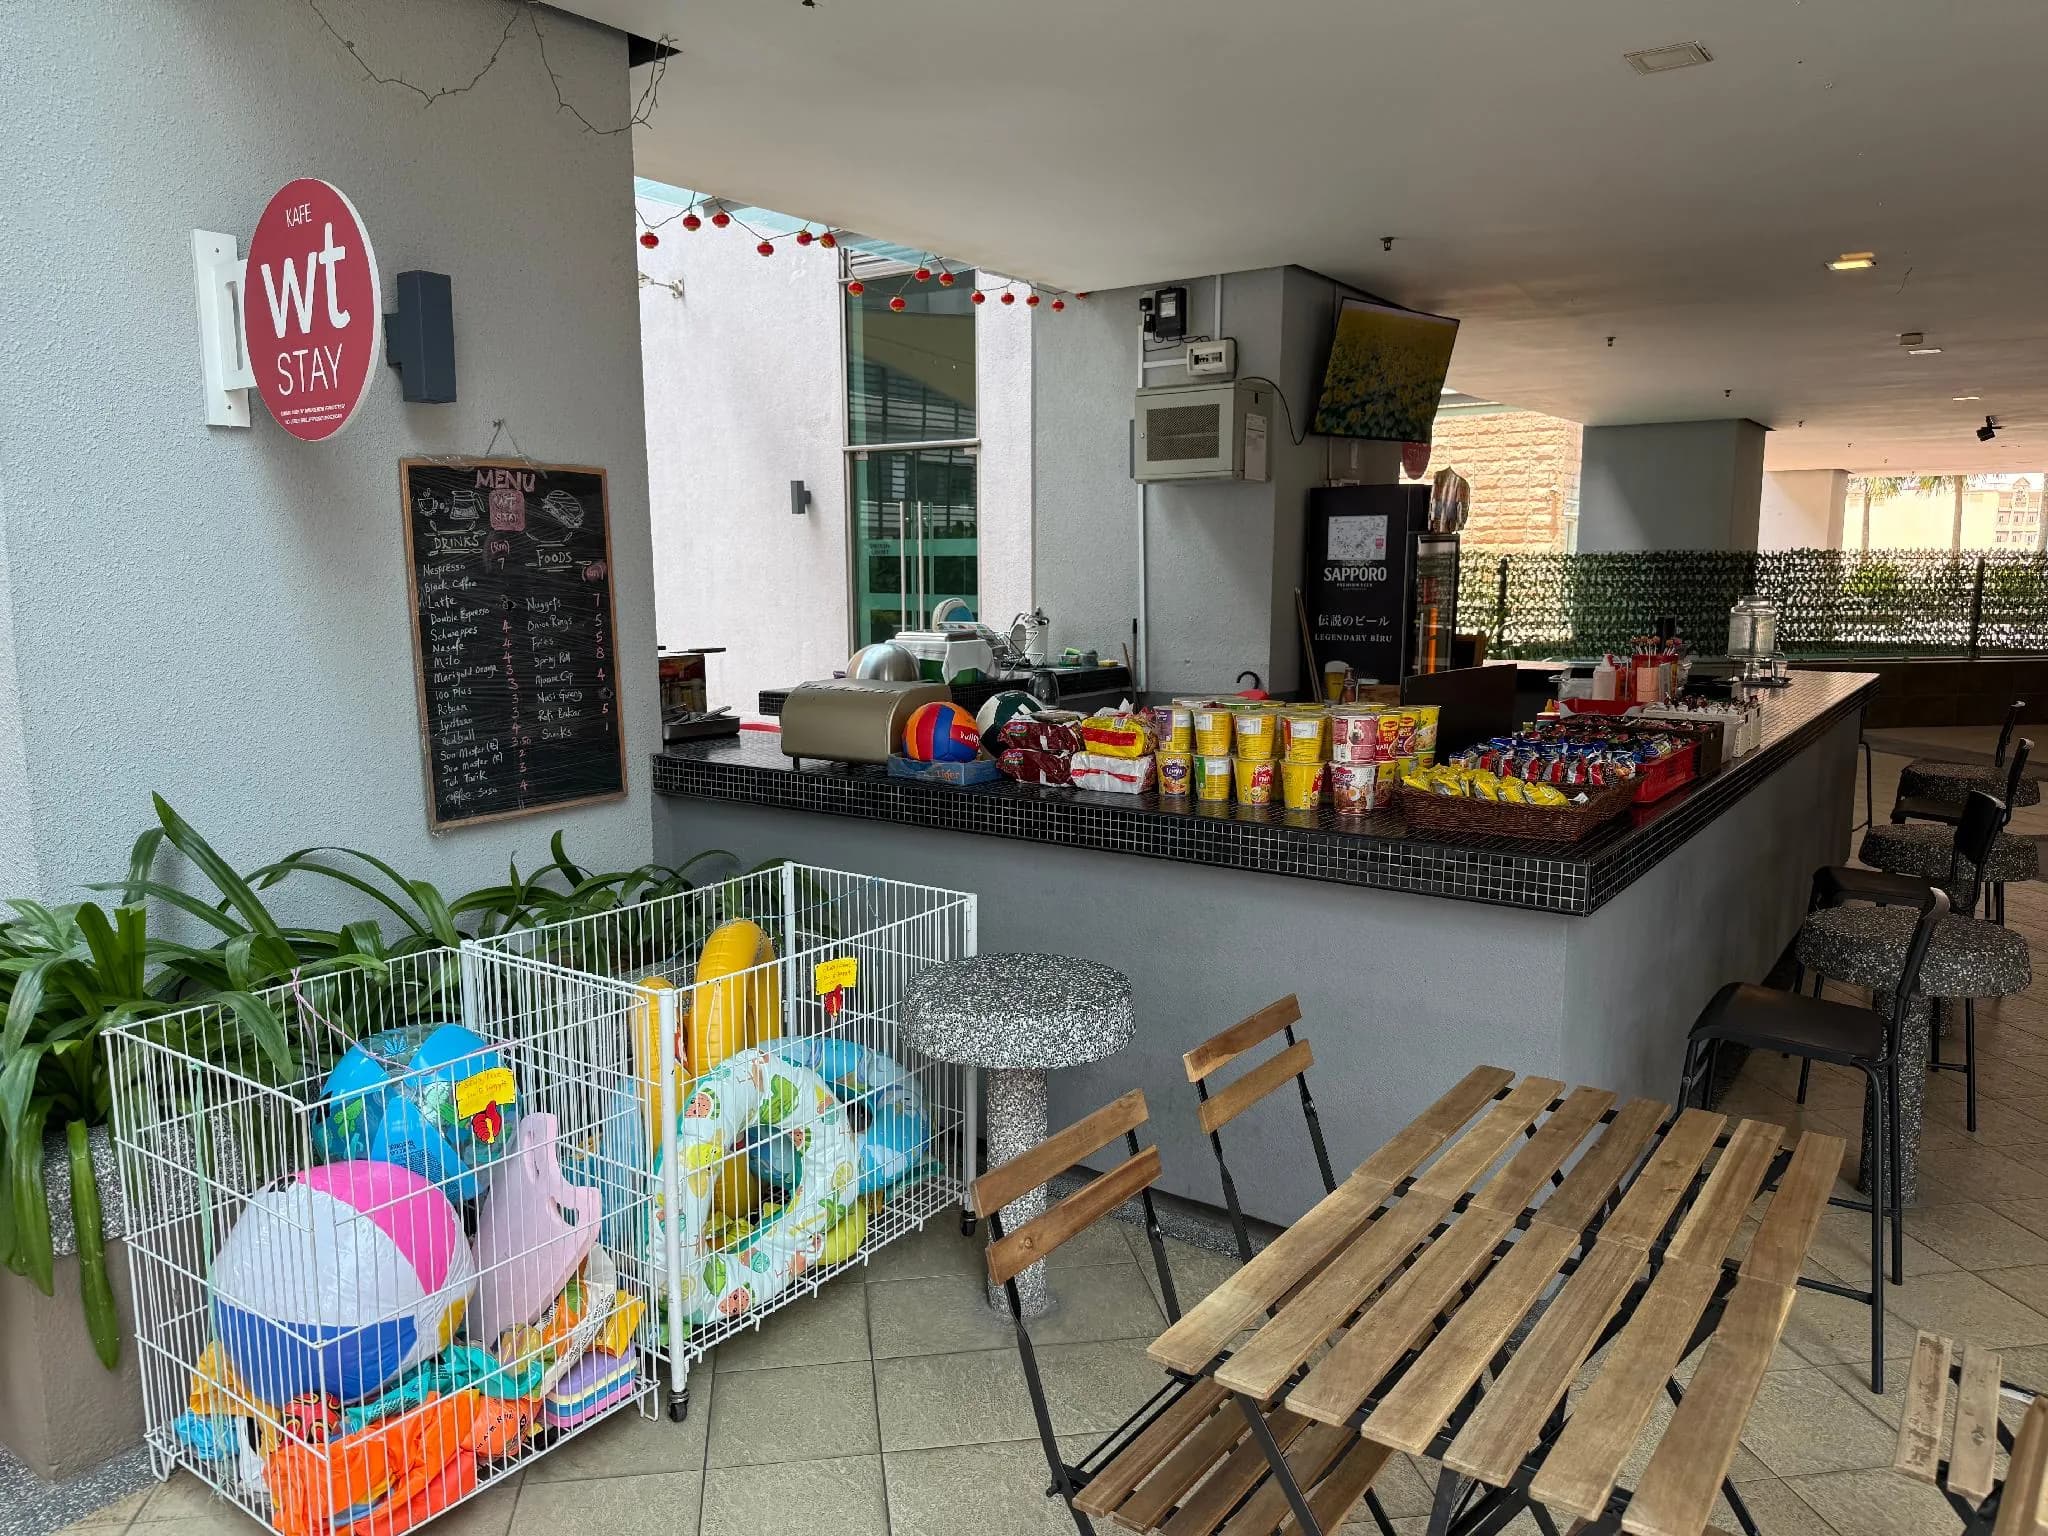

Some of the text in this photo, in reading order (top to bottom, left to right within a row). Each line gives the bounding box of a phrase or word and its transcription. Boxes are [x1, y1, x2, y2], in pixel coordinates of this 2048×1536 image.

[286, 203, 312, 227] KAFE
[277, 343, 342, 396] STAY
[475, 469, 535, 492] MENU
[434, 535, 479, 549] DRINKS
[497, 557, 505, 570] 7
[536, 548, 573, 567] FOODS
[423, 563, 466, 579] Nespresso
[1323, 566, 1387, 582] SAPPORO
[428, 594, 457, 608] Latte
[526, 597, 561, 613] Nuggets
[592, 593, 600, 607] 7
[430, 611, 458, 626] Double
[595, 613, 602, 626] 5
[1318, 614, 1390, 627] 伝説のビール
[502, 620, 512, 633] 4
[502, 639, 513, 648] 4
[595, 631, 603, 643] 5
[1314, 633, 1367, 642] LEGENDARY
[502, 651, 513, 663] 4
[596, 648, 604, 659] 8
[434, 655, 460, 669] Milo
[434, 667, 472, 686] Marigold
[506, 665, 514, 675] 3
[597, 667, 605, 680] 4
[508, 679, 519, 690] 3
[512, 693, 519, 704] 3
[512, 706, 520, 719] 3
[602, 702, 609, 714] 5
[512, 722, 521, 735] 4
[519, 750, 526, 758] 2
[519, 762, 527, 773] 3
[520, 779, 528, 791] 4
